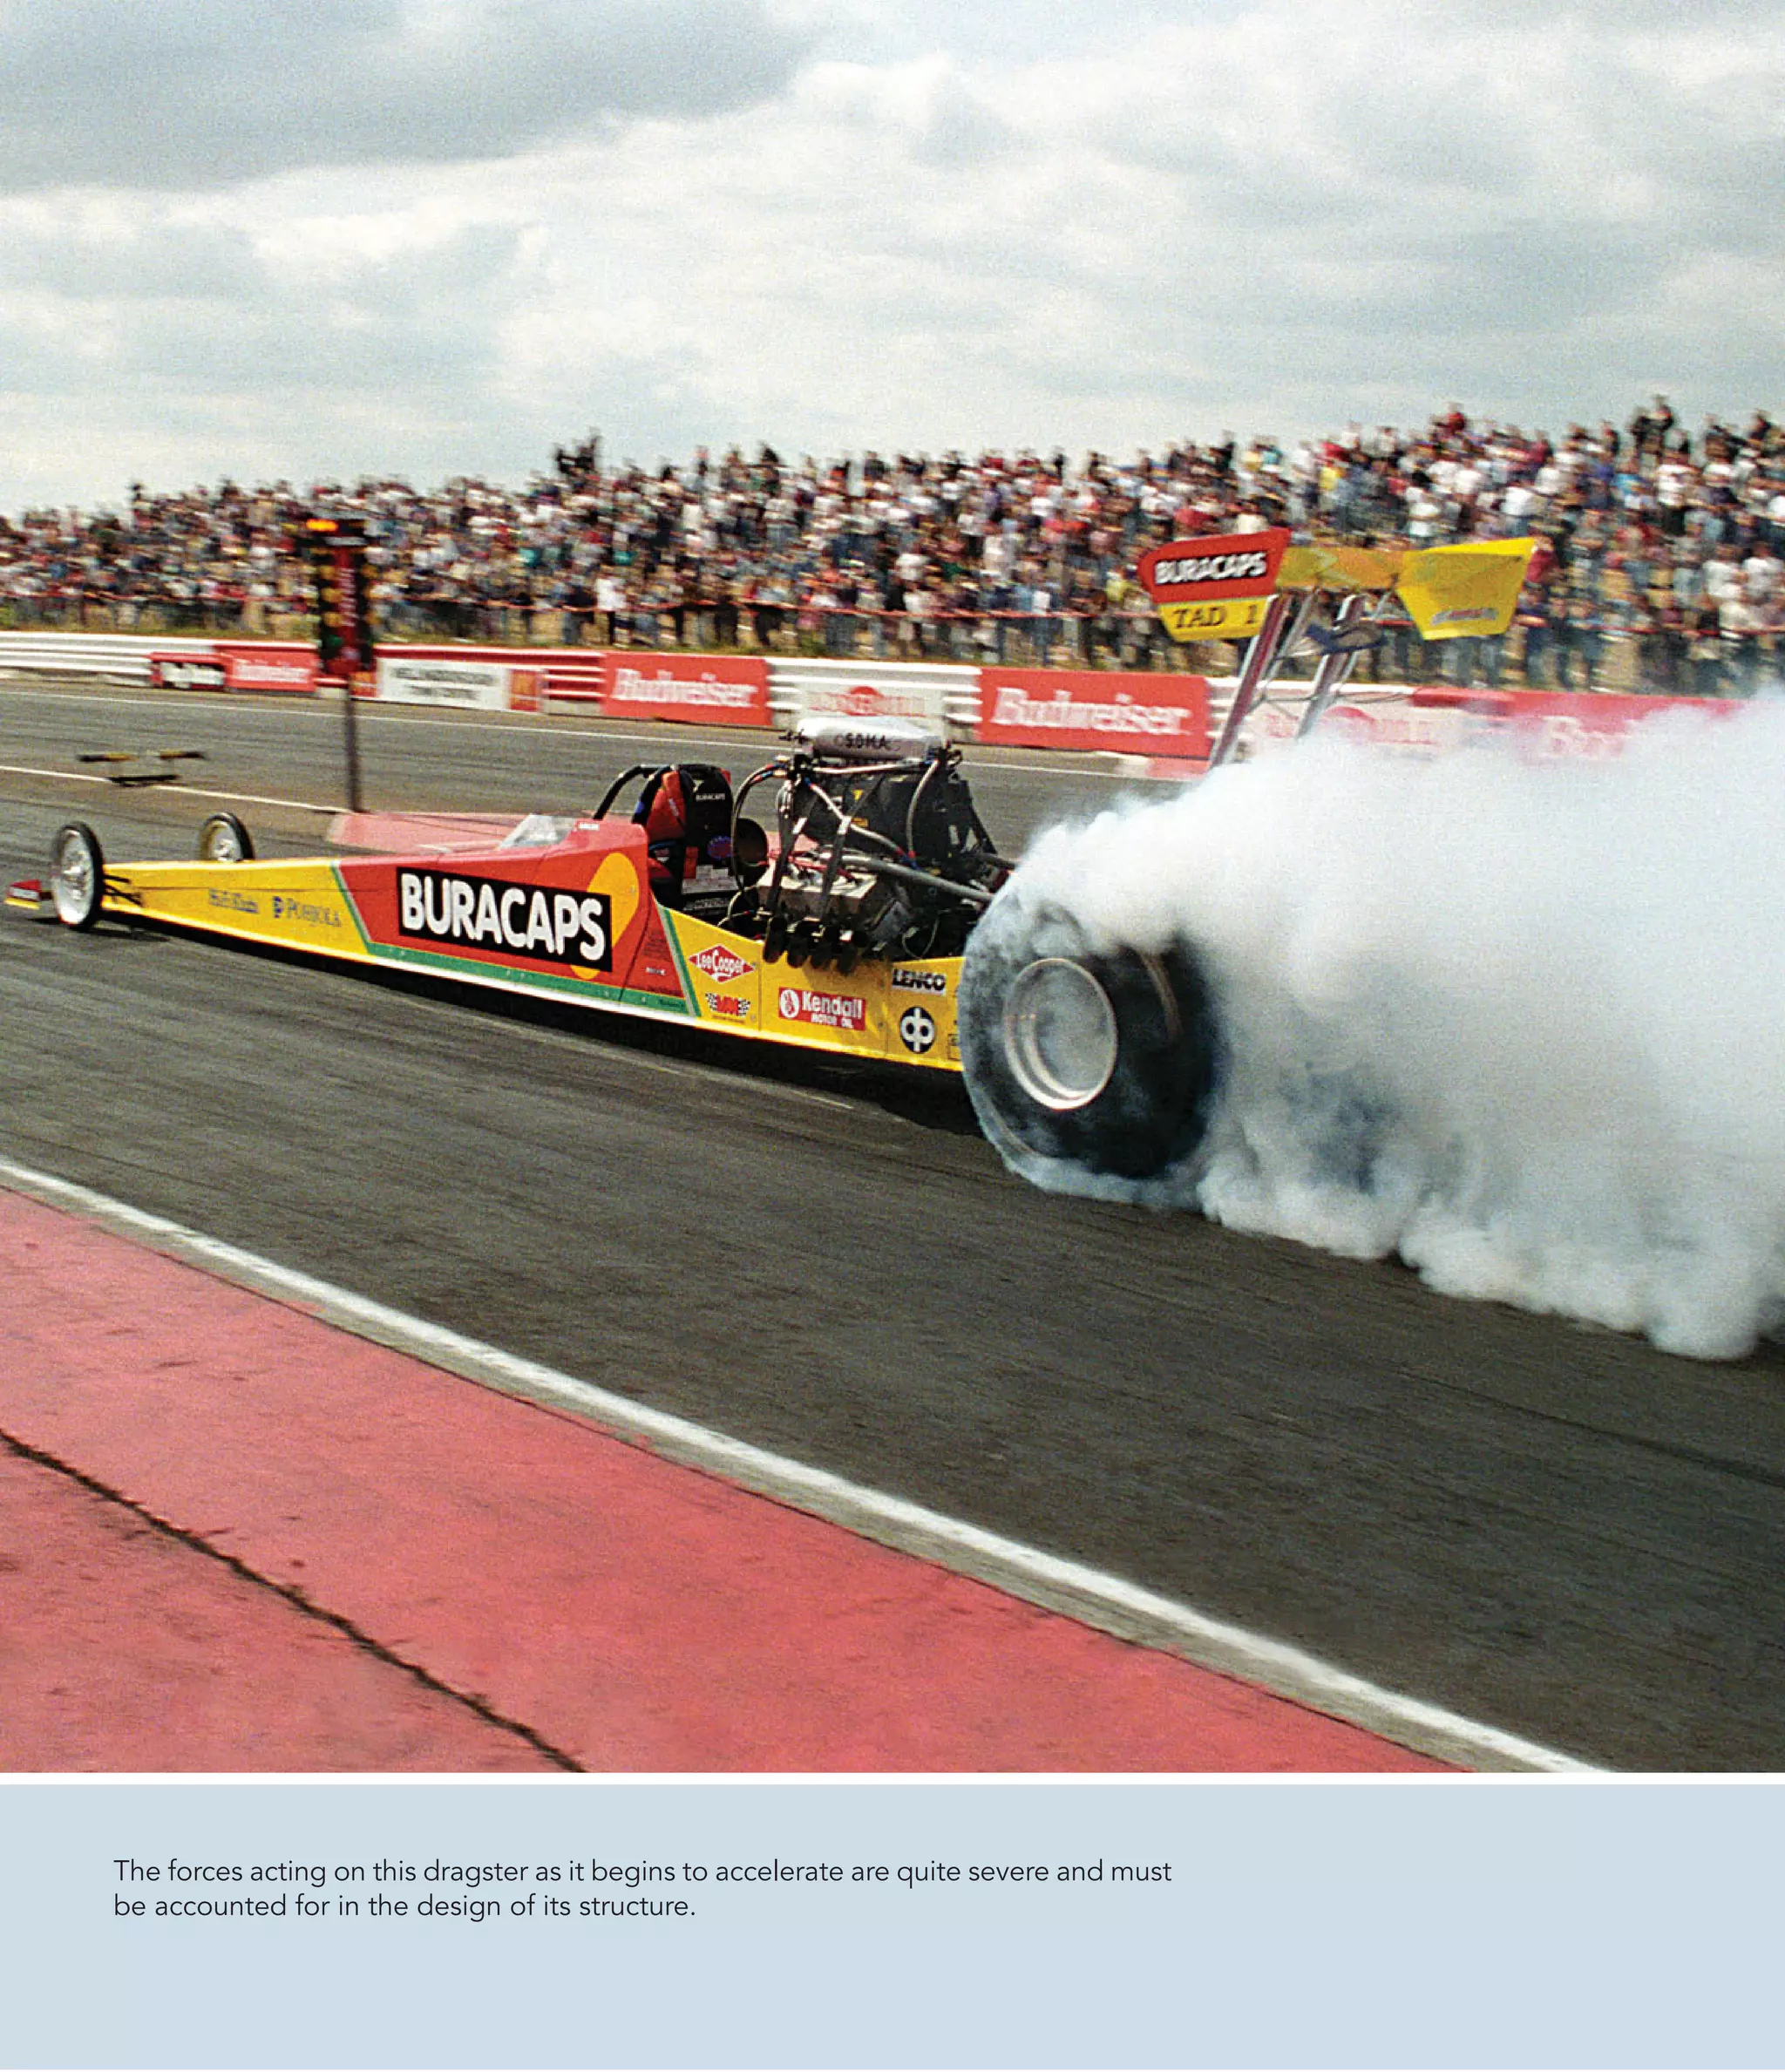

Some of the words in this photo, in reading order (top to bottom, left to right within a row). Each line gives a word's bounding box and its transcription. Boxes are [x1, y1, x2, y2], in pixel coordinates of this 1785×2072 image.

[1155, 552, 1267, 584] BURACAPS
[1173, 605, 1227, 628] TAD
[1245, 603, 1259, 625] 1
[991, 687, 1191, 736] Budweiser
[401, 873, 605, 961] BURACAPS
[892, 968, 947, 991] LENCO
[802, 990, 863, 1019] Kendall
